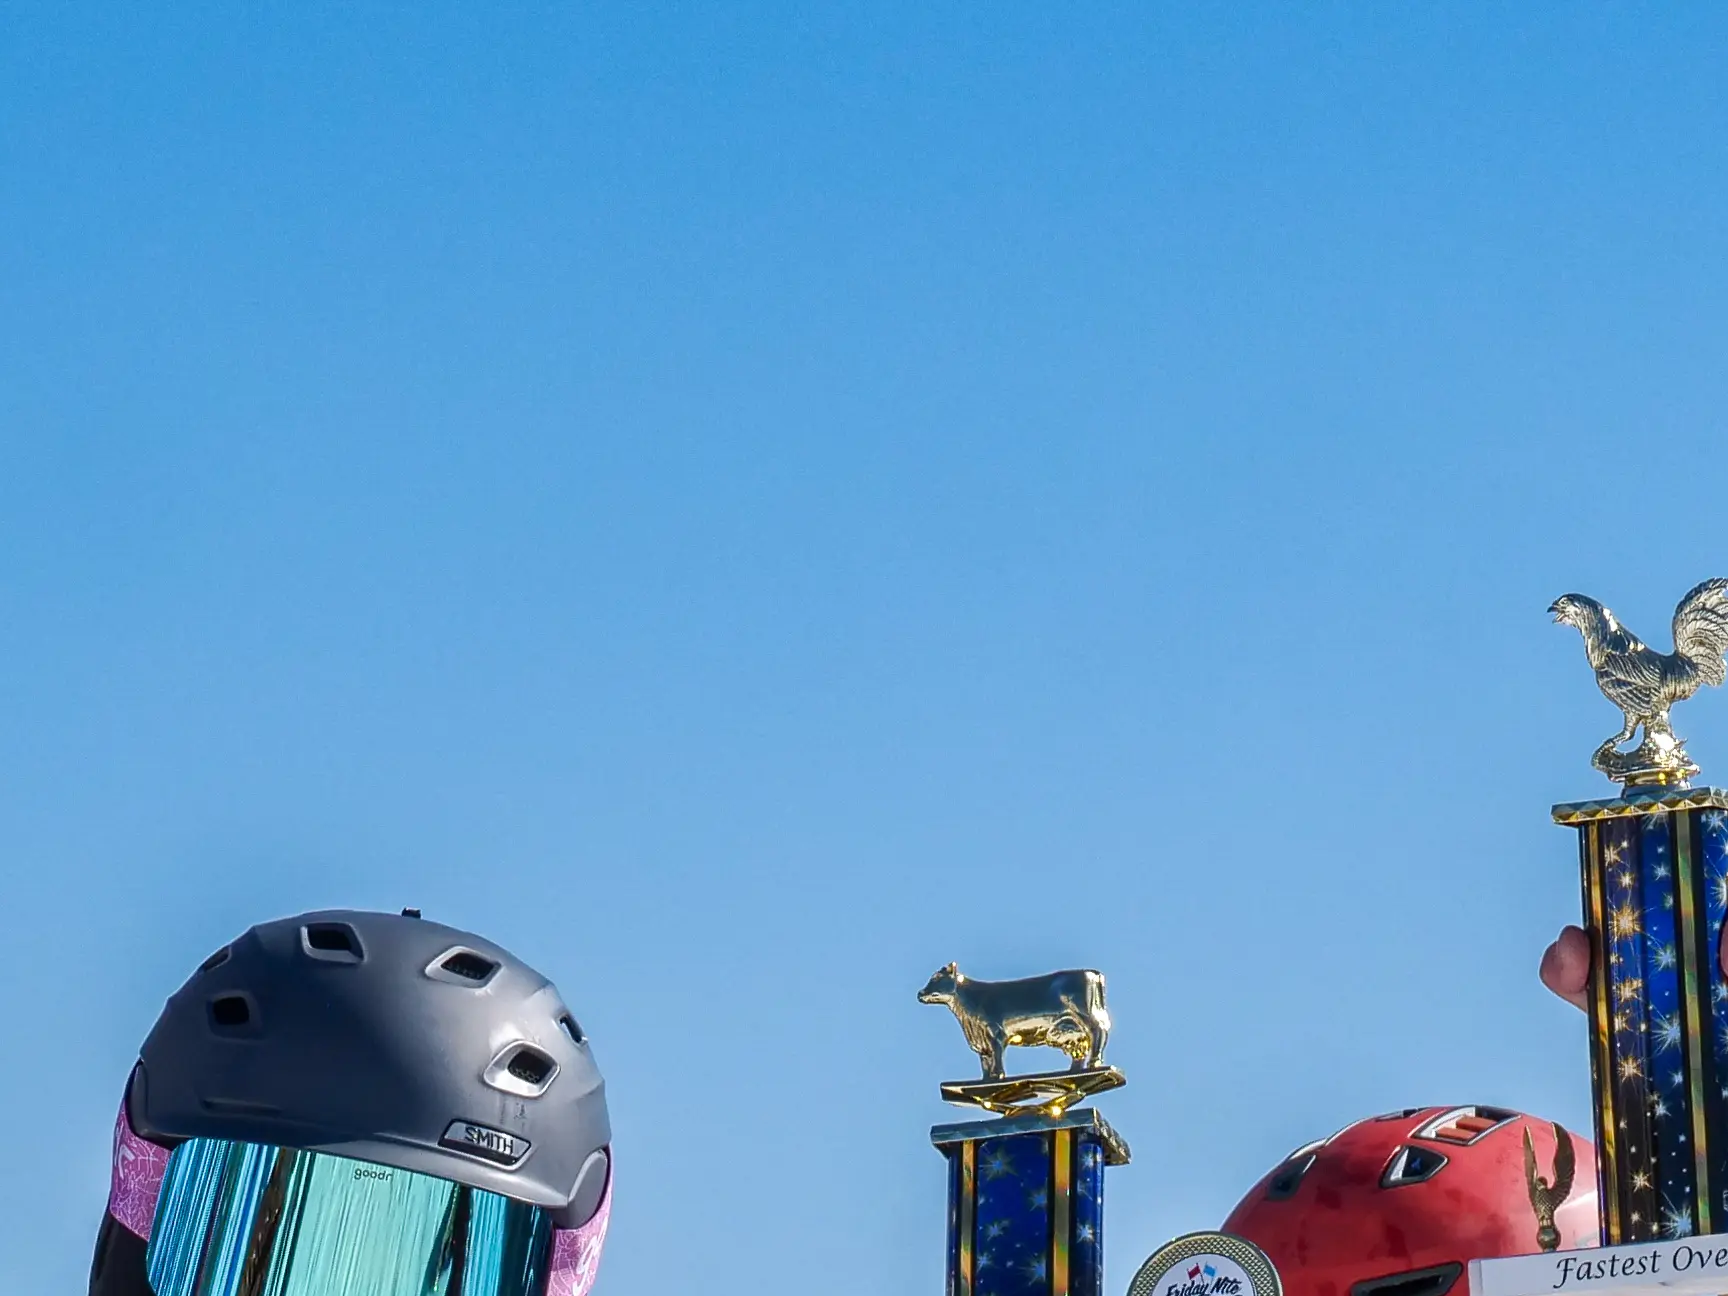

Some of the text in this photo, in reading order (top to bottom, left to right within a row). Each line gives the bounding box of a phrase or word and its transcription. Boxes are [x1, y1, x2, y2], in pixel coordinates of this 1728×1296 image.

[465, 1126, 514, 1155] SMITH
[354, 1168, 392, 1181] goodr
[1552, 1249, 1662, 1289] Fastest
[1210, 1276, 1242, 1295] Nite
